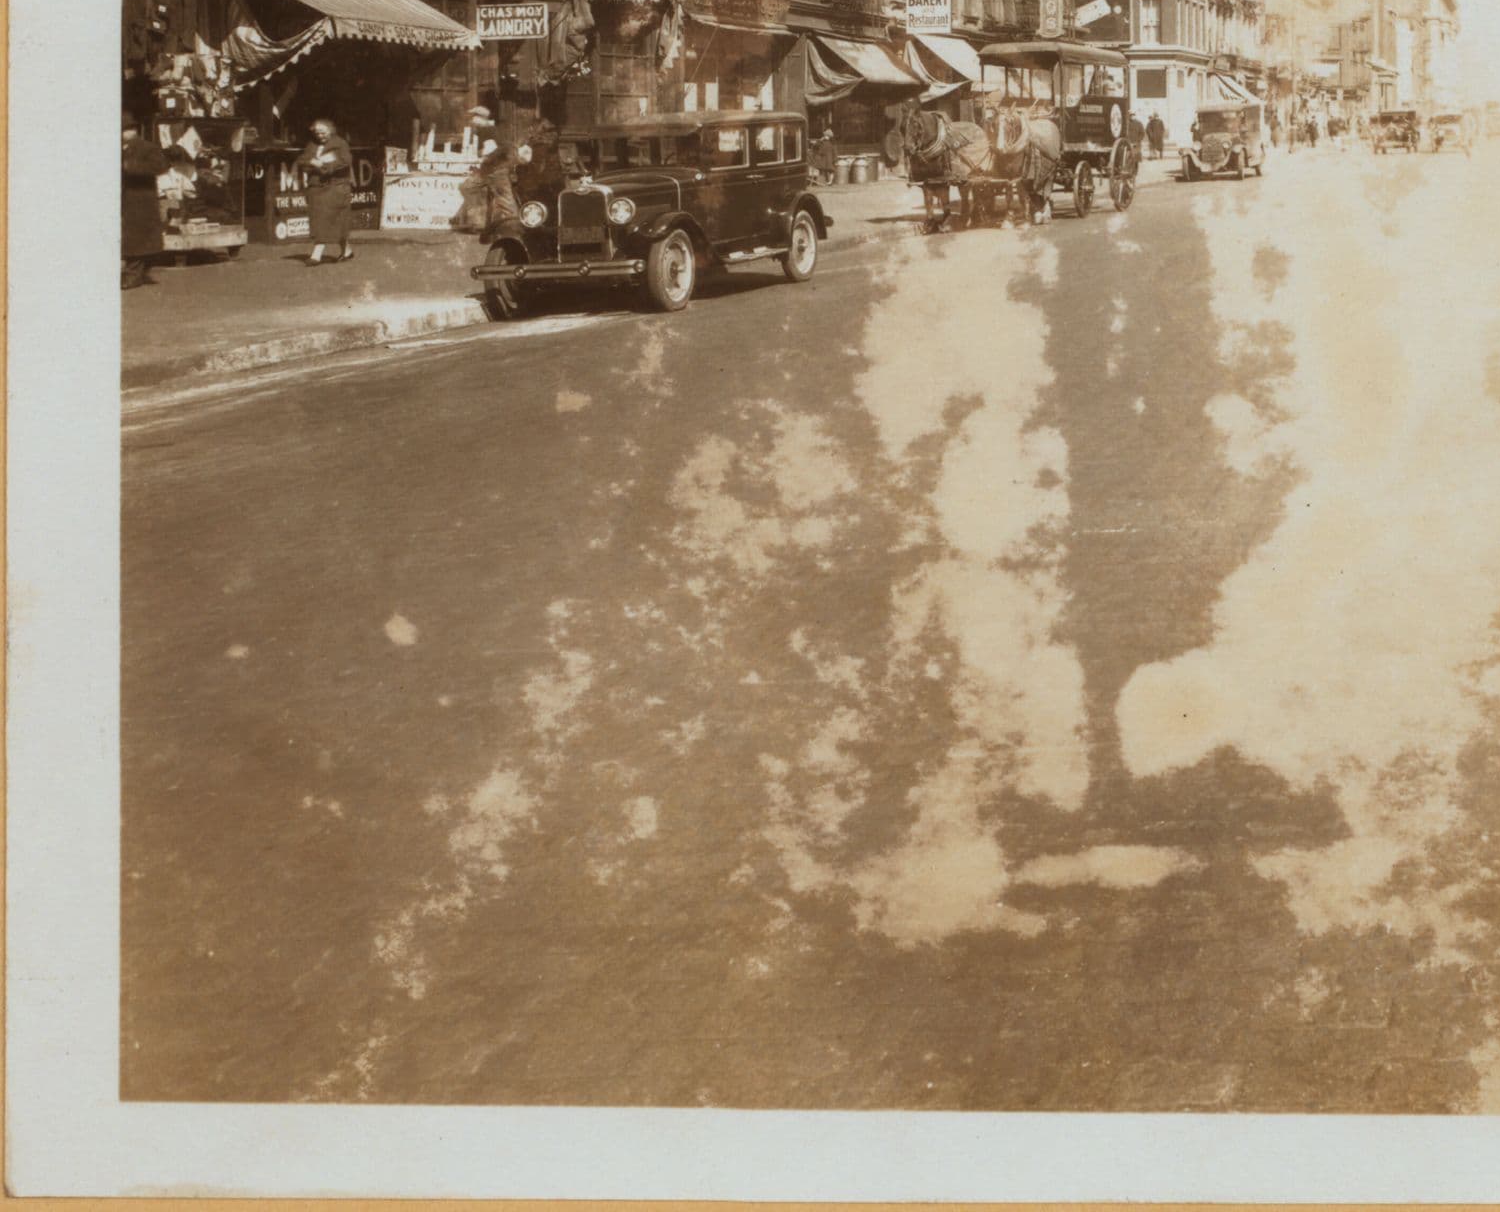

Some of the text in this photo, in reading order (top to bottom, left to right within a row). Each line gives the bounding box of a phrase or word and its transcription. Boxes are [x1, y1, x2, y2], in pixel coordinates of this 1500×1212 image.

[480, 6, 543, 19] CHAS MOY
[479, 18, 544, 37] LAUNDRY
